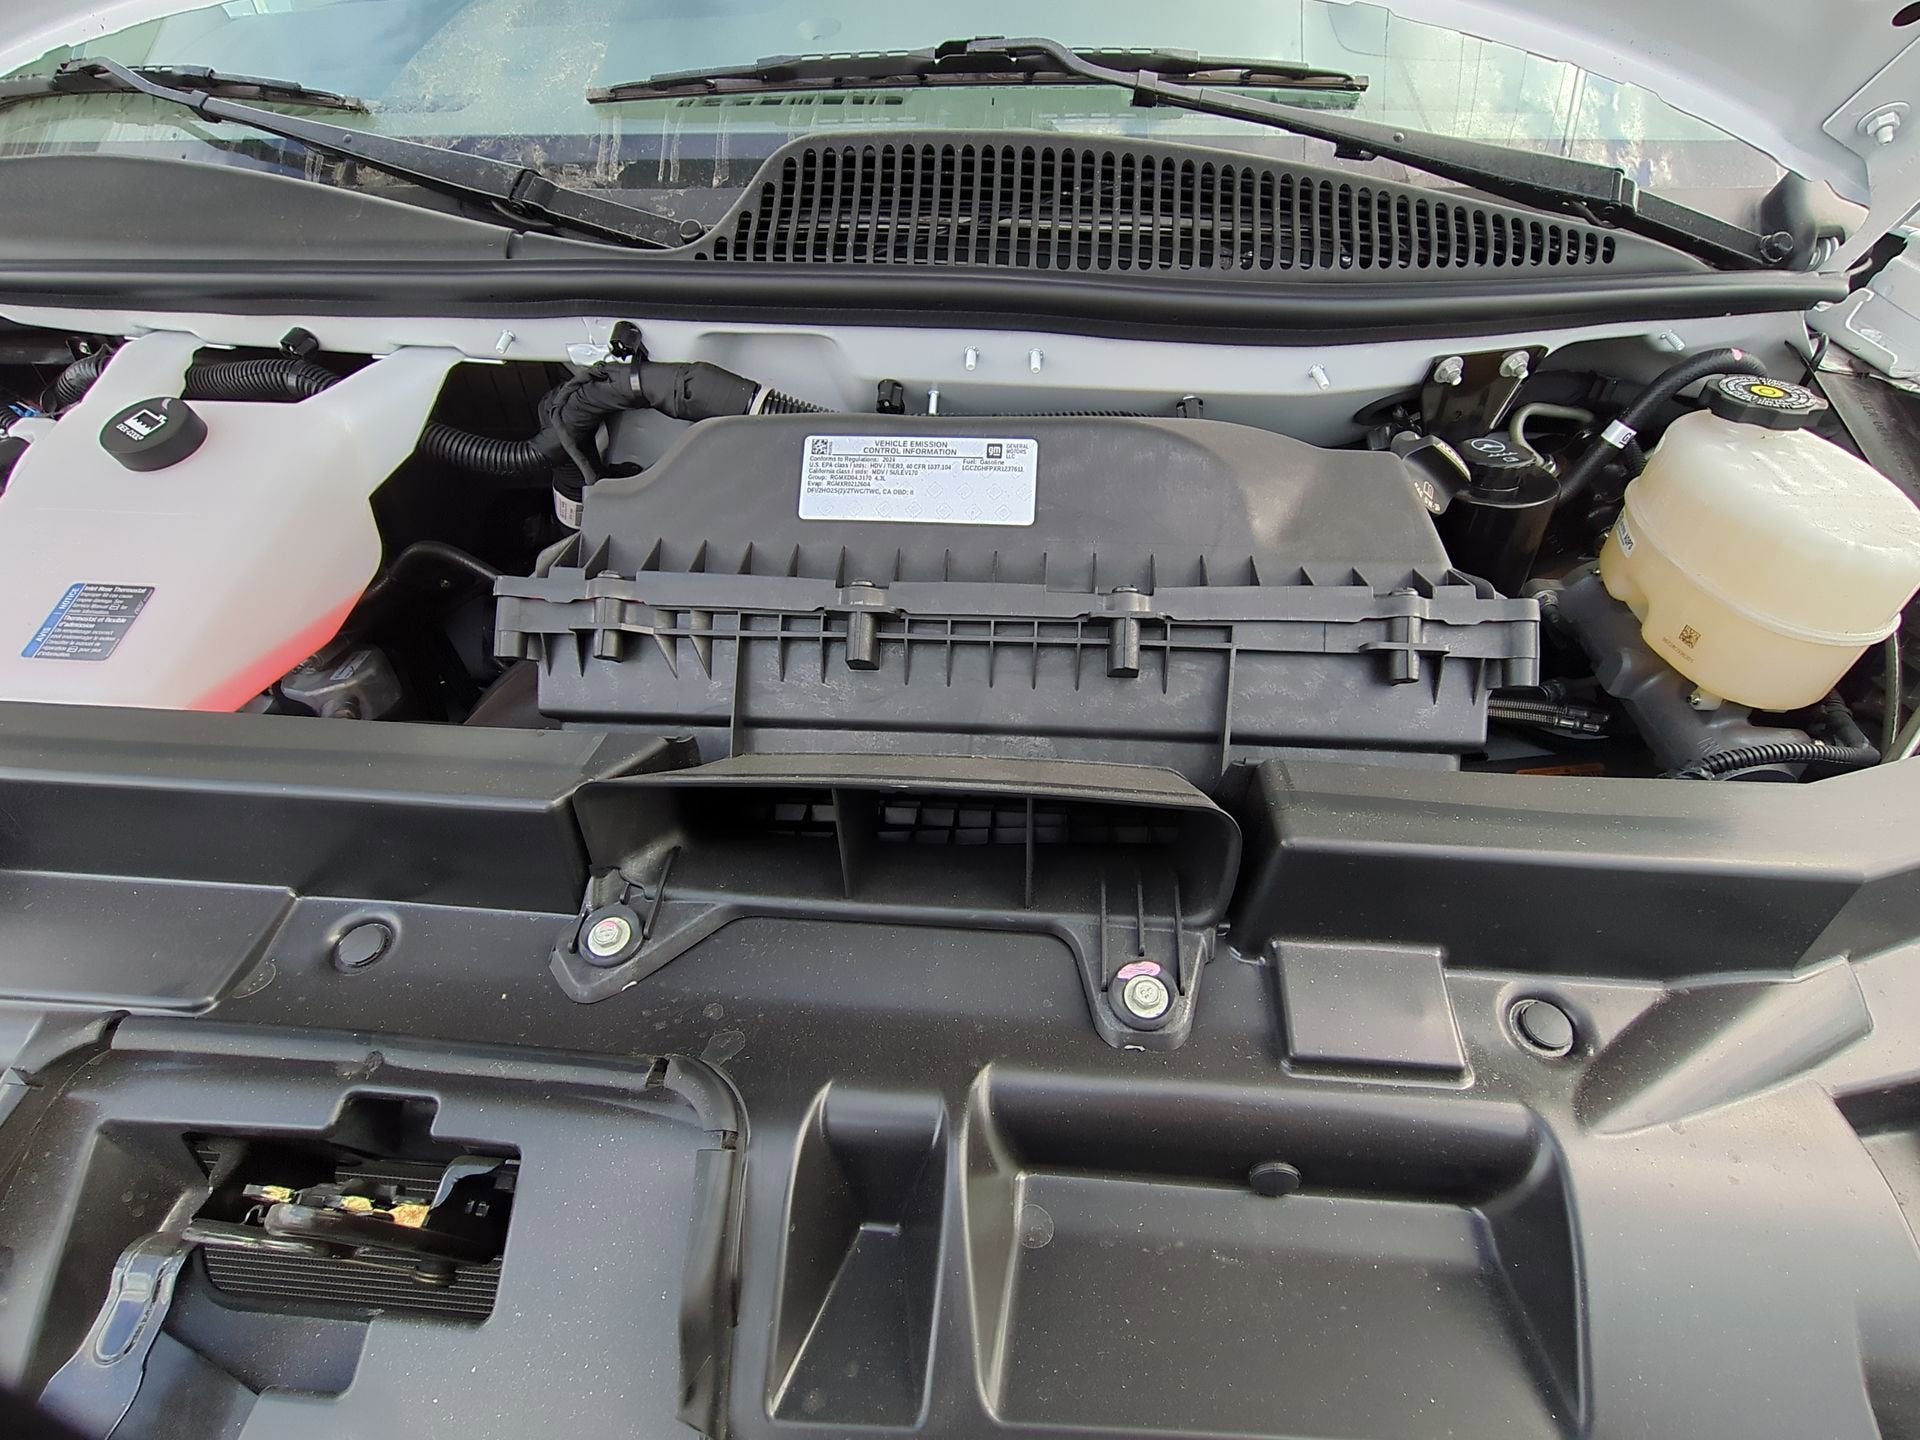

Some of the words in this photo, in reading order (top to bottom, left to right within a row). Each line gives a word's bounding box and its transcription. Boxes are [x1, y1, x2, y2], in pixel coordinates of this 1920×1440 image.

[910, 440, 948, 448] EMISSION
[863, 446, 901, 454] CONTROL
[902, 447, 957, 455] INFORMATION
[58, 587, 81, 610] NOTICE
[35, 626, 52, 642] AVIS
